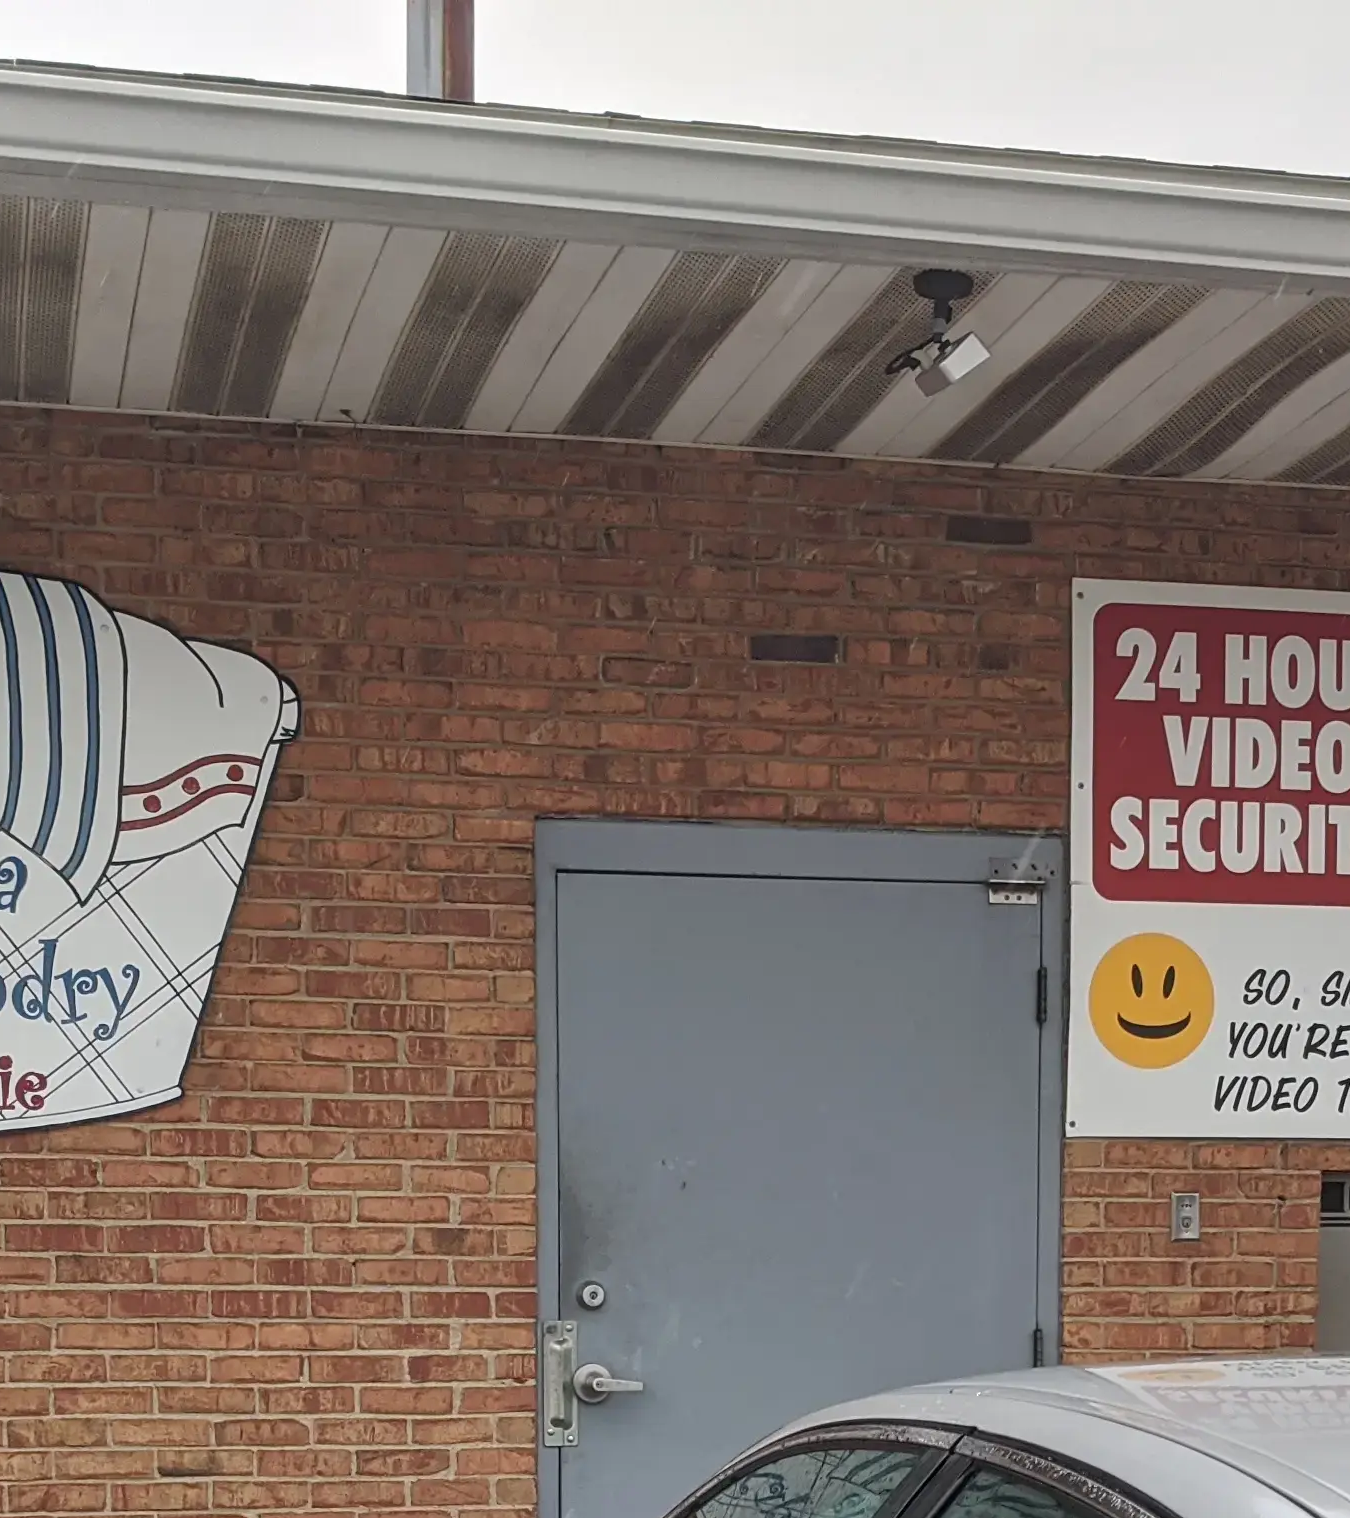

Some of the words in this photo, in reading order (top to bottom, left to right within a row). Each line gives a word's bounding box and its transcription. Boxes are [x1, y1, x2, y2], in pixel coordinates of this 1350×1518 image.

[1114, 627, 1201, 703] 24
[1243, 968, 1300, 1011] SO,
[1213, 1075, 1319, 1112] VIDEO
